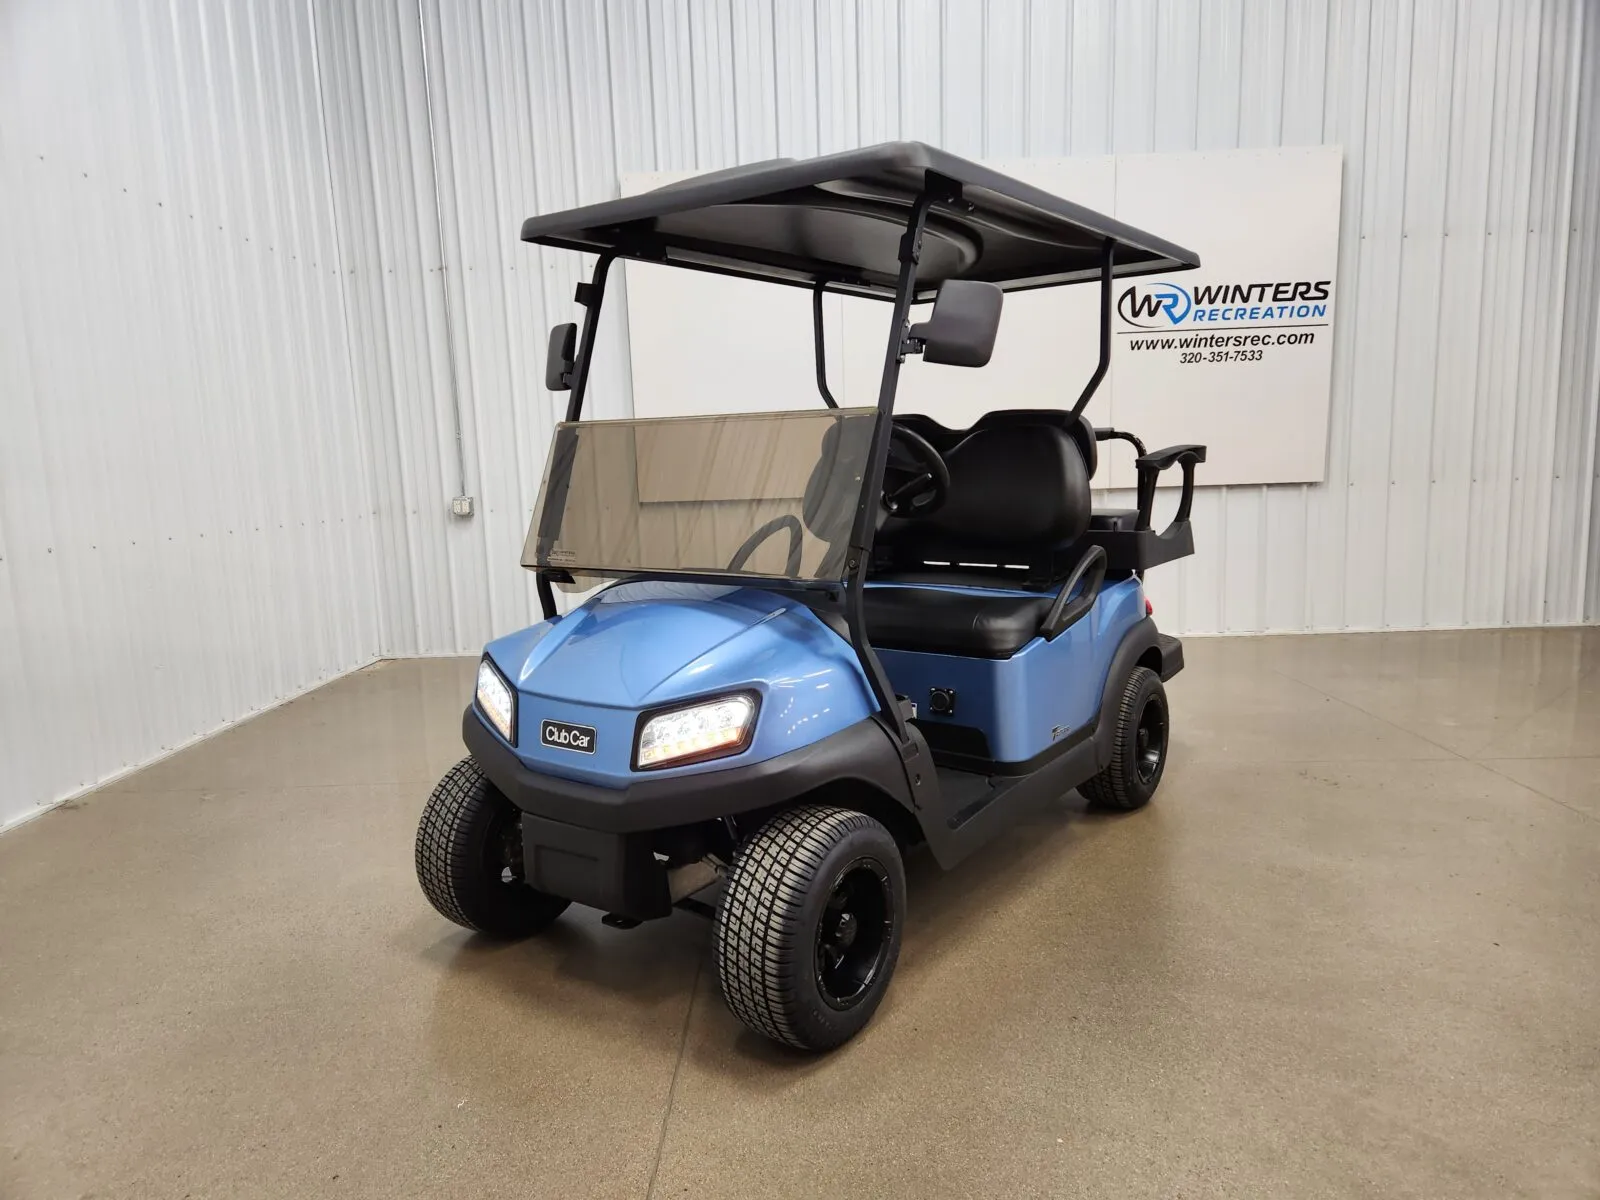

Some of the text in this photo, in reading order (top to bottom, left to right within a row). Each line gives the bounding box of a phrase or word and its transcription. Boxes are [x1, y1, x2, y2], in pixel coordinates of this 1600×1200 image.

[1193, 280, 1331, 305] WINTERS
[1193, 304, 1327, 322] RECREATION
[1130, 332, 1315, 351] www.wintersrec.com
[1179, 350, 1263, 364] 320-351-7533
[546, 726, 590, 747] Club Car
